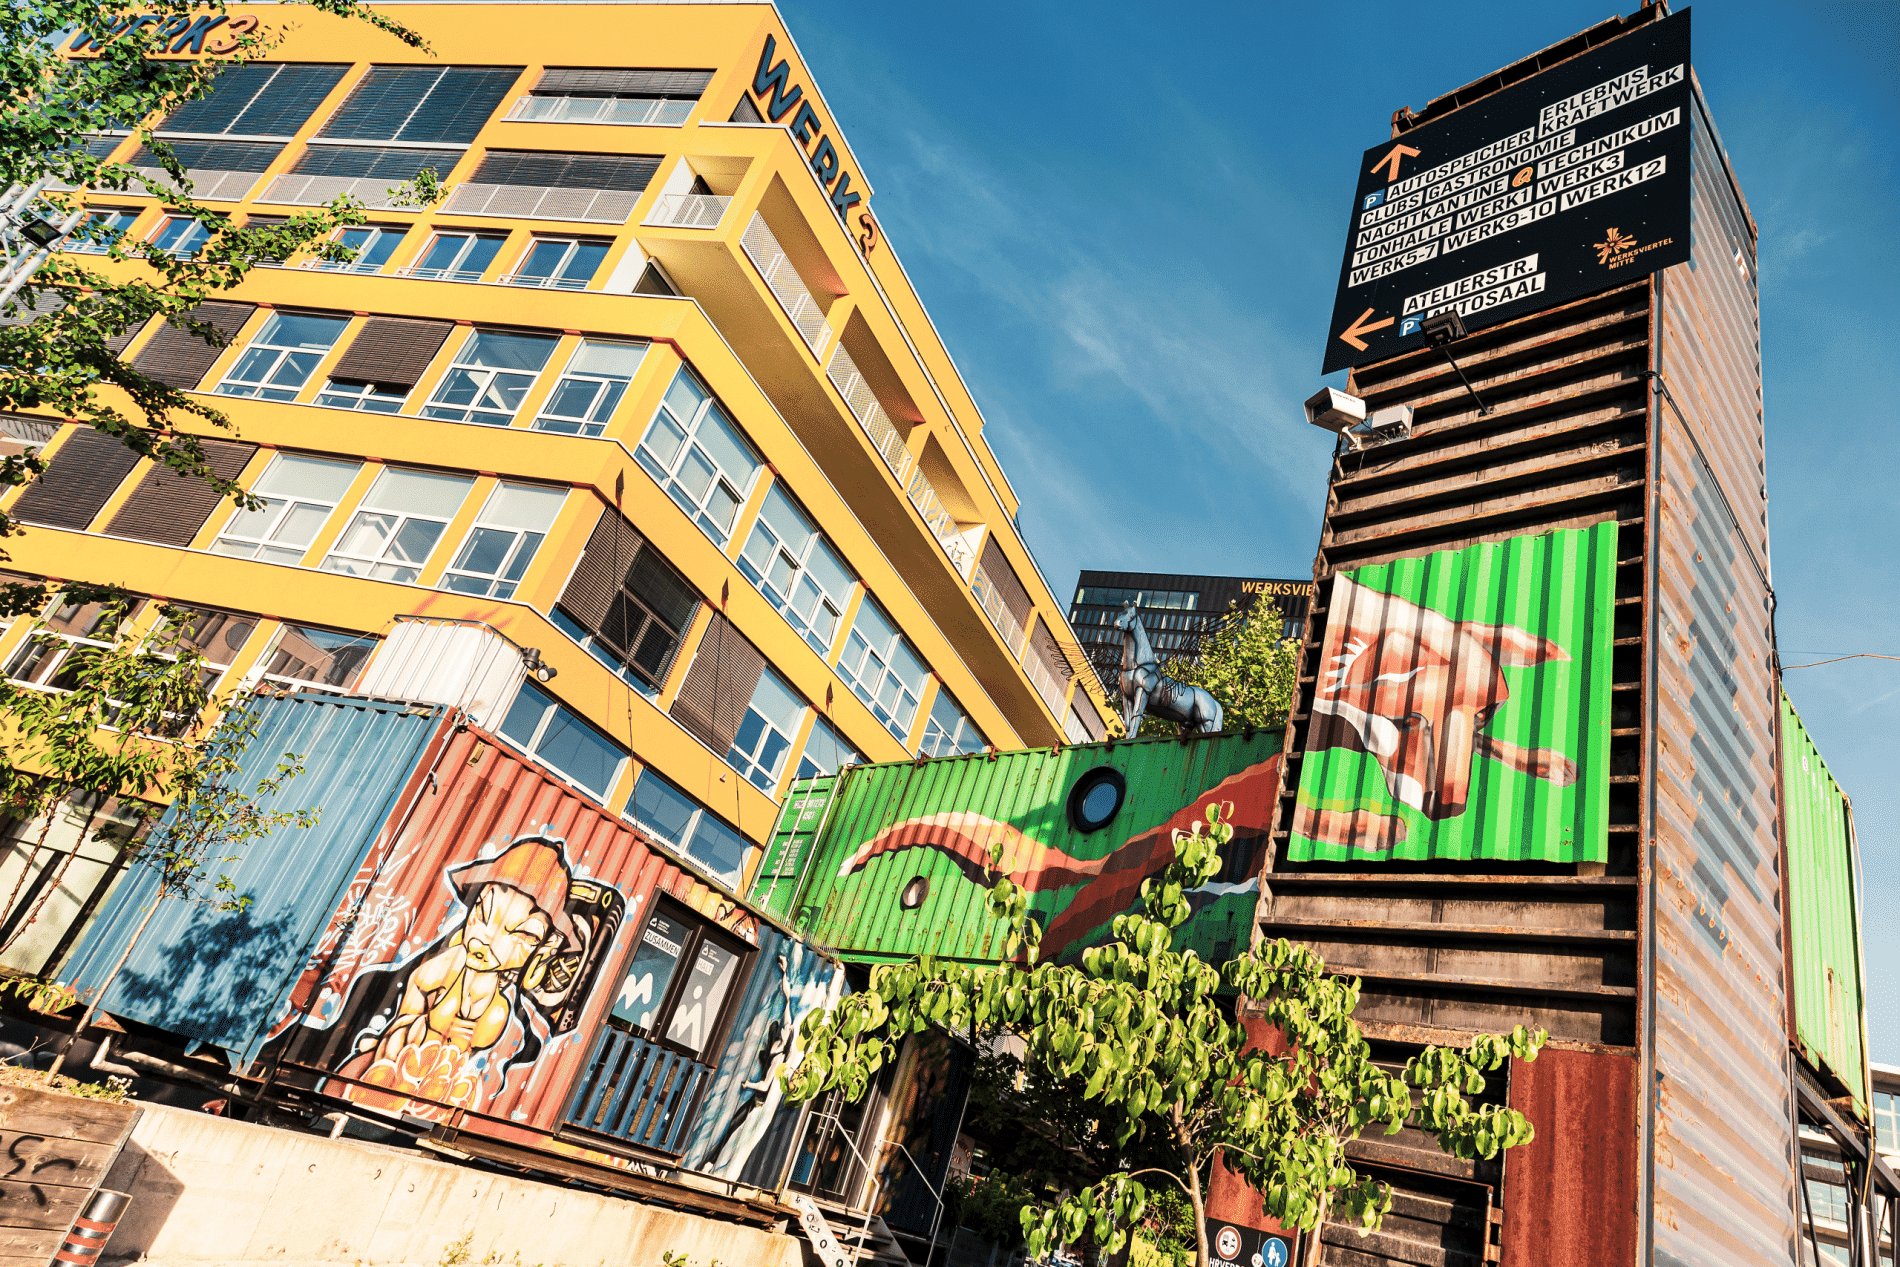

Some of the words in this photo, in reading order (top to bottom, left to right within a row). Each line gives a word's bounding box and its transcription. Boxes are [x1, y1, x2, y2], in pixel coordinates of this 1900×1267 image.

[1541, 66, 1680, 135] KRAFTWERK
[1543, 69, 1645, 121] ERLEBNIS
[1359, 178, 1505, 244] NACHTKANTINE
[1542, 111, 1675, 175] TECHNIKUM
[1363, 194, 1420, 225] CLUBS
[1428, 131, 1571, 200] GASTRONOMIE
[1389, 130, 1531, 199] AUTOSPEICHER
[1353, 244, 1436, 285] WERK5-7
[1448, 201, 1553, 250] WERK9-10
[1566, 160, 1661, 206] WERK12
[1356, 219, 1450, 264] TONHALLE
[1461, 189, 1528, 226] WERK1
[1541, 154, 1620, 195] WERK3
[1608, 237, 1673, 263] WERKSVIERTEL
[1608, 256, 1635, 270] MITTE
[1406, 260, 1533, 313] ATELIERSTR.
[644, 931, 681, 956] ZUSAMMEN
